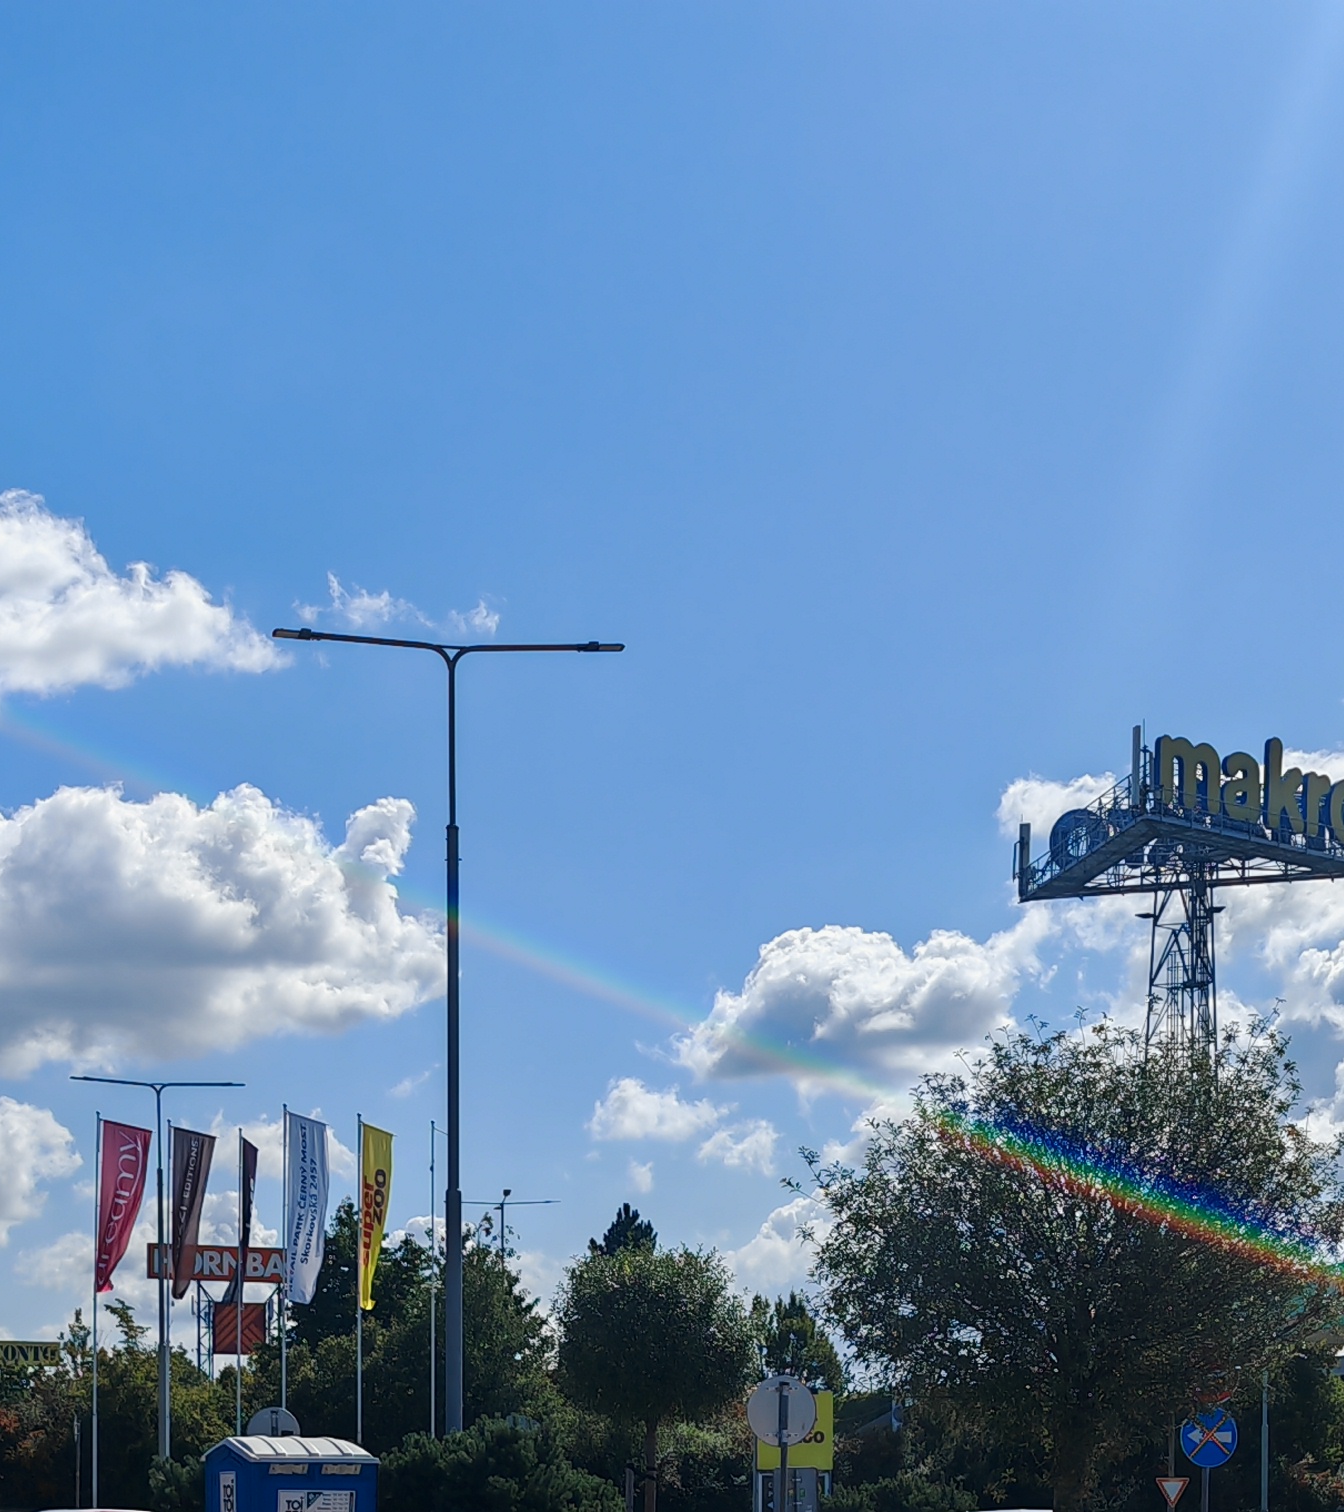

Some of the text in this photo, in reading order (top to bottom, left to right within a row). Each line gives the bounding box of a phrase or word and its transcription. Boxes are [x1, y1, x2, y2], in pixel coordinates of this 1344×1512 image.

[183, 1139, 199, 1199] EDITIONS
[299, 1123, 307, 1163] MOST
[362, 1175, 374, 1268] super
[373, 1169, 387, 1226] zoo
